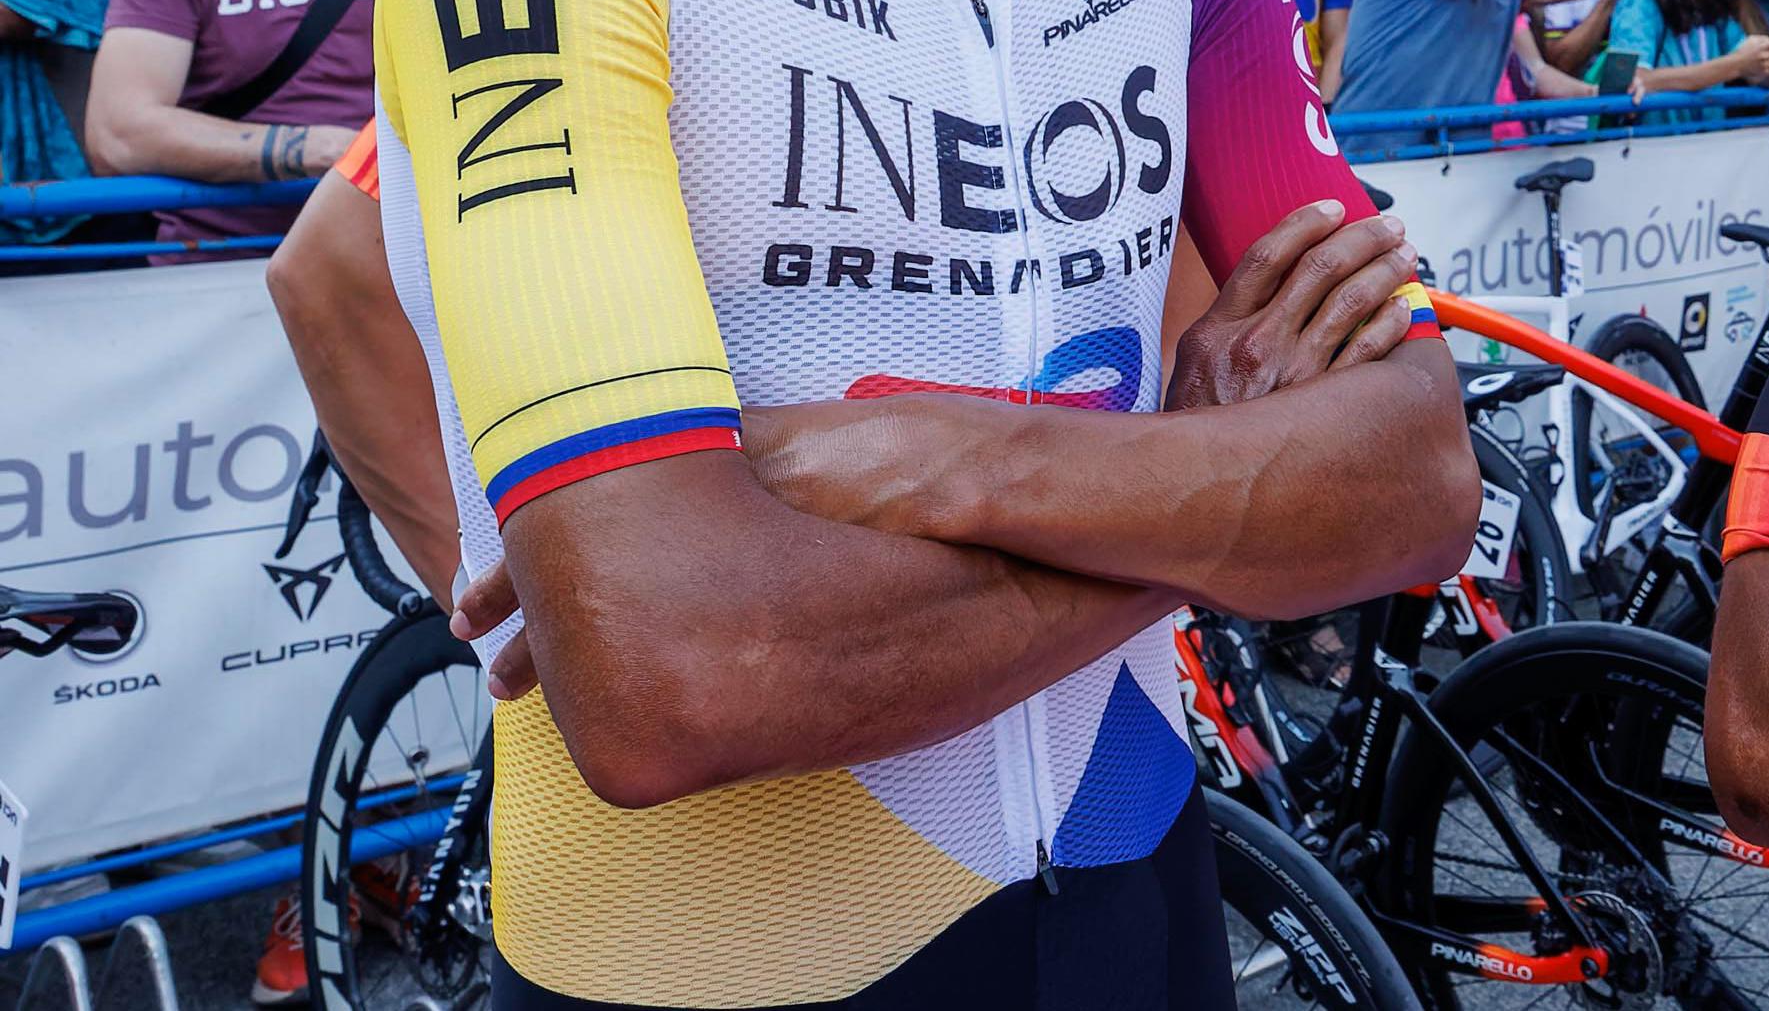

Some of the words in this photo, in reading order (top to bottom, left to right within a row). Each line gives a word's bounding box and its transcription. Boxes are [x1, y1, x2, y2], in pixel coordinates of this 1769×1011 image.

[771, 62, 1172, 236] INEOS
[763, 215, 1174, 296] GRENADIER
[0, 420, 333, 543] auto
[53, 673, 161, 706] ŠKODA
[1351, 696, 1383, 789] GRENADIER
[419, 769, 482, 903] CANYON
[1659, 817, 1765, 866] PINARELLO
[1267, 905, 1357, 1005] ZIPP
[1431, 942, 1534, 982] PINARELLO
